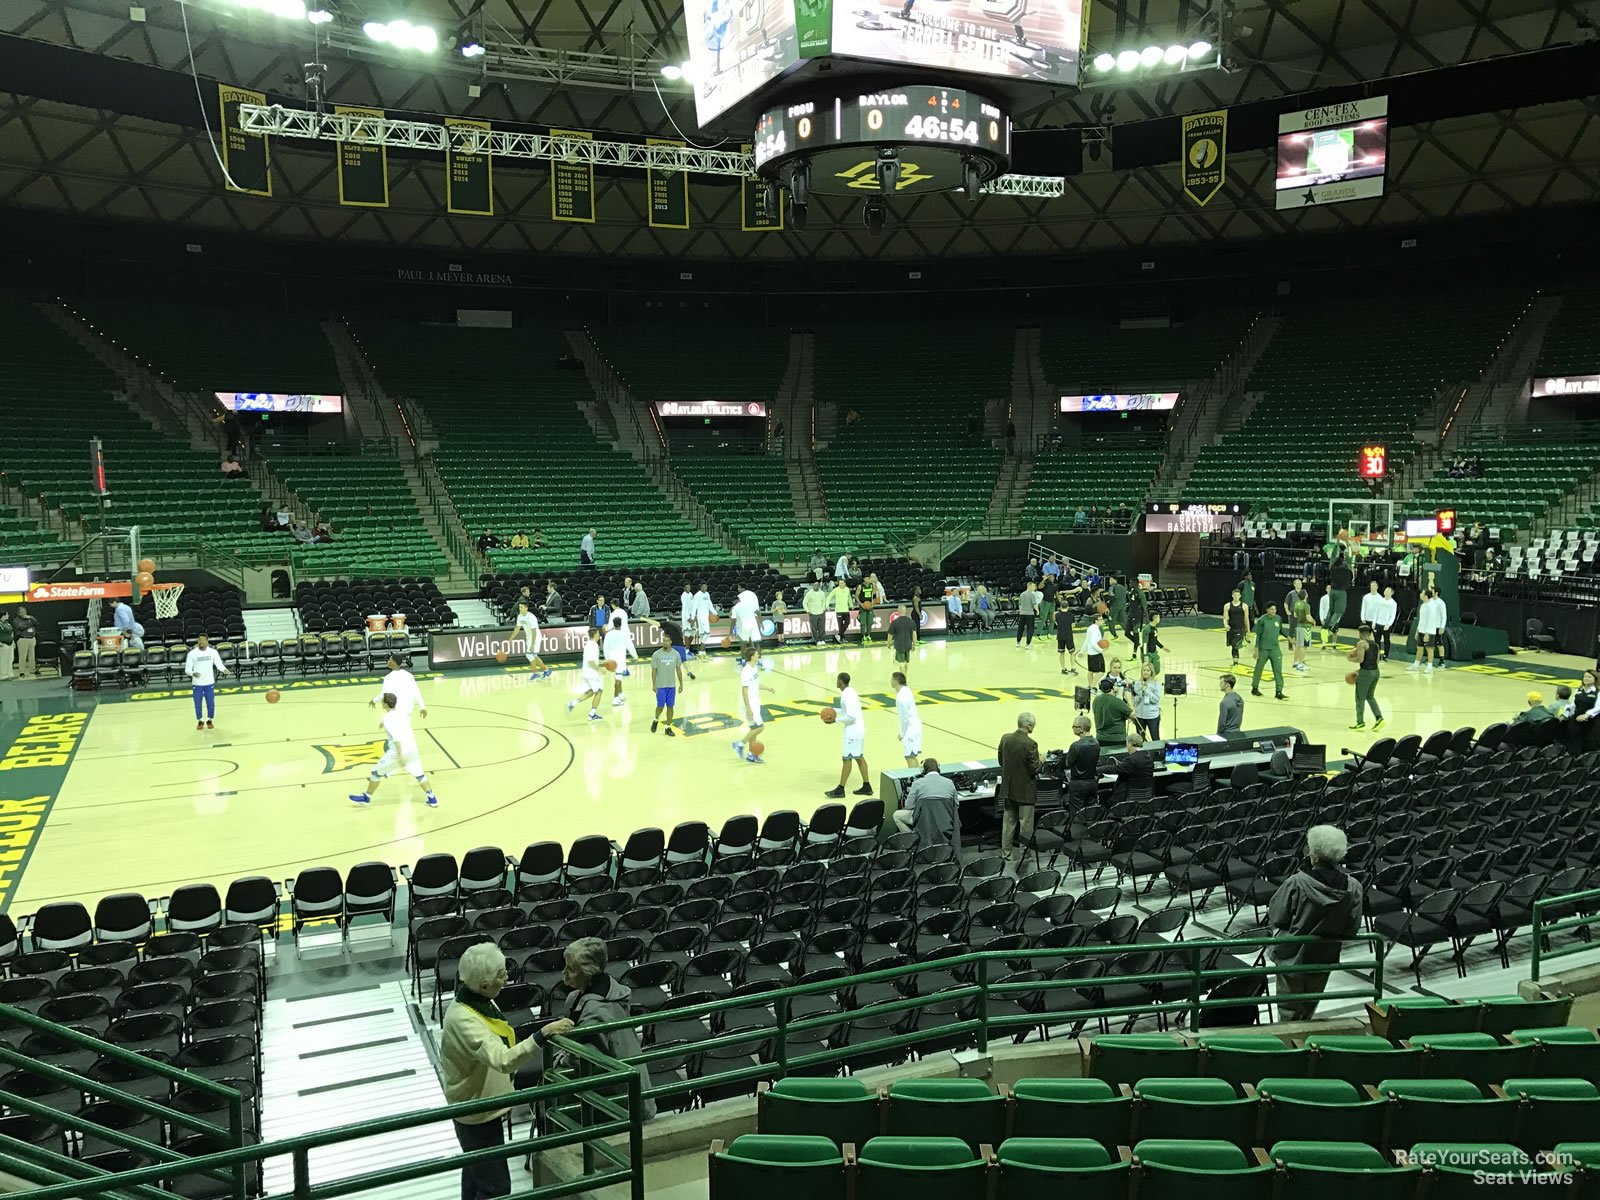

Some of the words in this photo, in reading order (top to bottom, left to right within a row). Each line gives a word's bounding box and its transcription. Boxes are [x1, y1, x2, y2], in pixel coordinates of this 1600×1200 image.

[963, 22, 976, 36] TO
[979, 25, 998, 40] THE
[859, 94, 908, 106] BAYLOR
[928, 96, 938, 106] 4
[952, 99, 961, 109] 4
[868, 109, 883, 130] 0
[1304, 118, 1322, 129] ROOF
[1326, 112, 1360, 125] SYSTEMS
[1305, 102, 1358, 121] CEN-TEX
[799, 117, 811, 138] 0
[905, 115, 979, 144] 46:54
[989, 121, 998, 141] 0
[1185, 116, 1224, 132] BAYLOR
[1187, 175, 1219, 186] 1953-95
[1321, 186, 1357, 199] GRANDE
[398, 270, 424, 280] PAUL
[437, 272, 474, 282] MEYER
[476, 273, 512, 284] ARENA
[1367, 456, 1383, 474] 30
[1168, 522, 1225, 532] BASKETBAL
[457, 635, 526, 658] Welcom
[541, 632, 559, 653] to
[565, 627, 590, 651] the
[1451, 664, 1583, 688] BEA
[0, 712, 88, 770] BEARS
